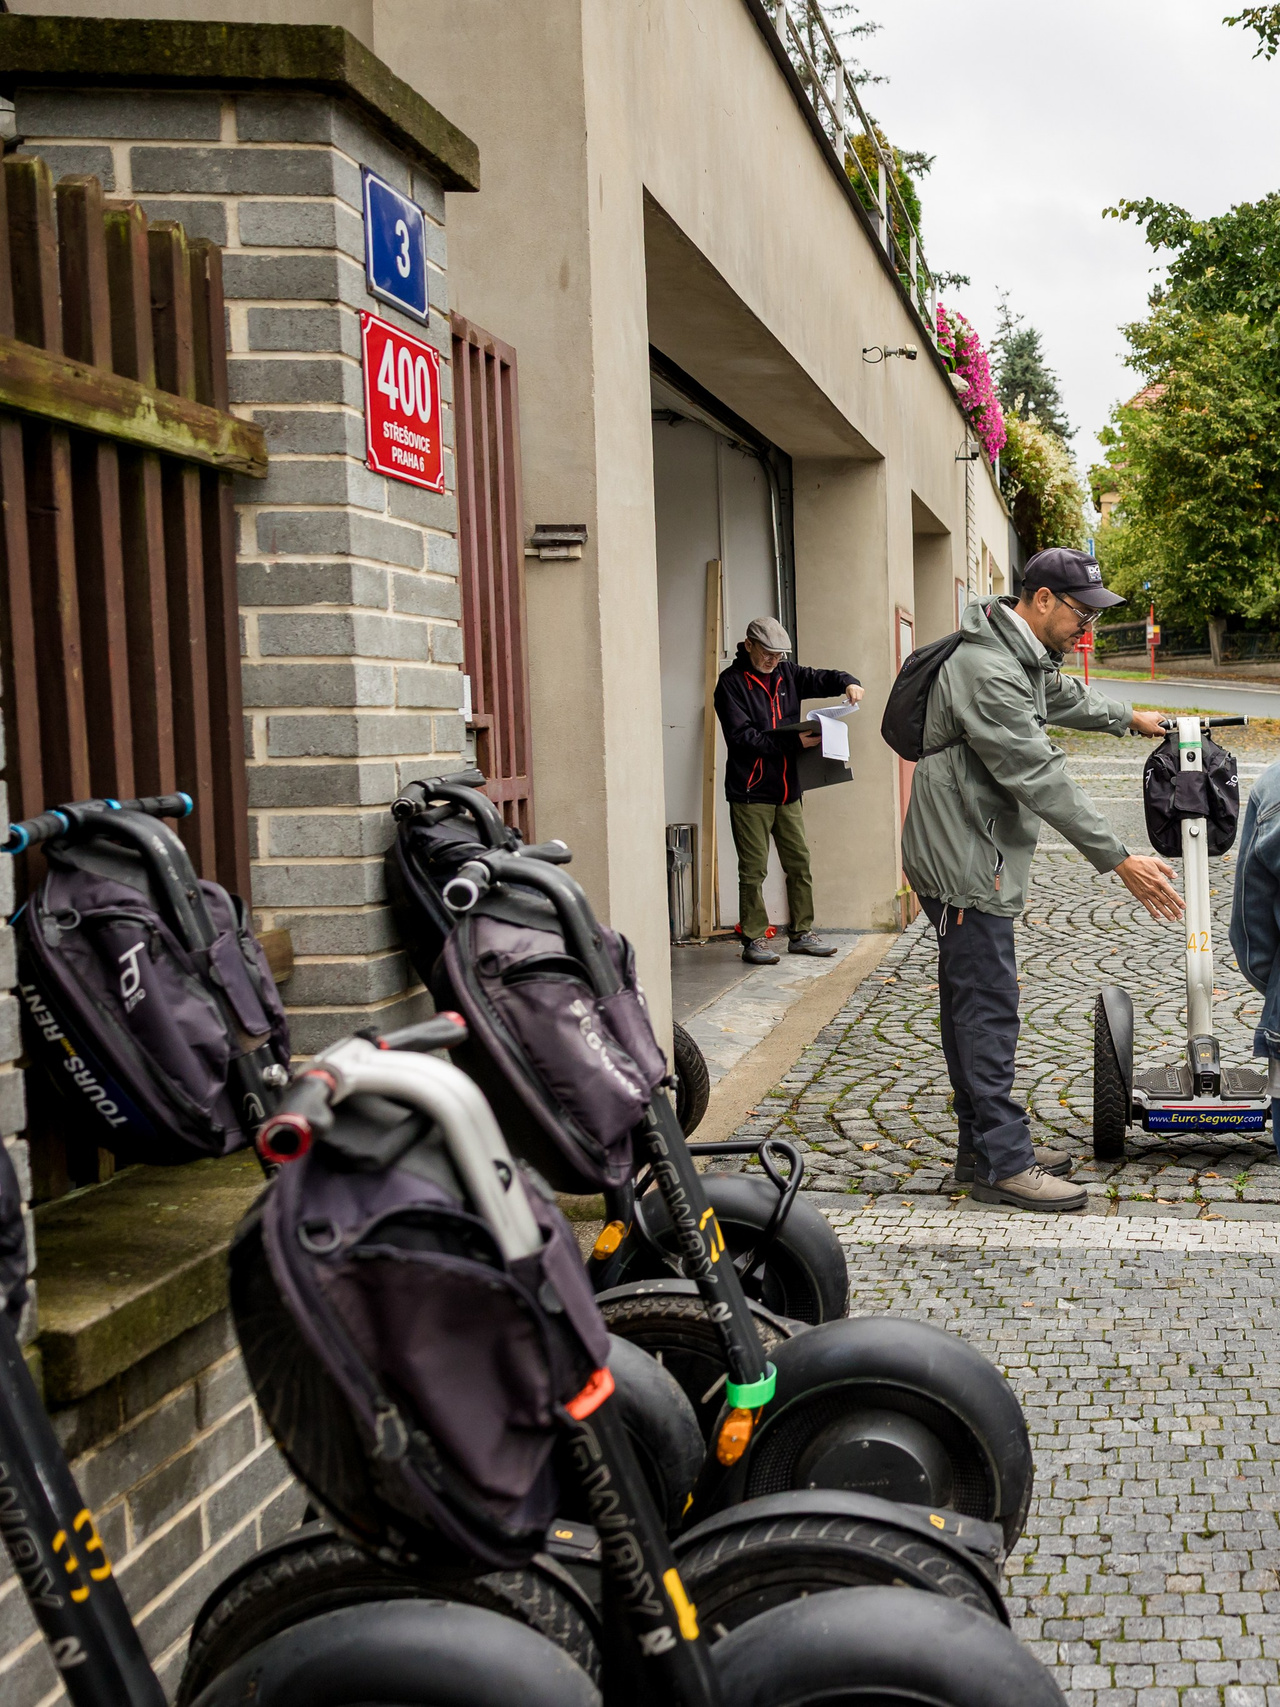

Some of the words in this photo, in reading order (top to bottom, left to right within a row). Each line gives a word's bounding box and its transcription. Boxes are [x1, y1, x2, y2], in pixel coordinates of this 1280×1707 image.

[395, 219, 411, 279] 3
[377, 338, 432, 424] 400
[383, 421, 431, 454] STŘEŠOVICE
[391, 446, 419, 471] PRAHA
[419, 460, 425, 472] 6
[1187, 931, 1210, 953] 42
[20, 984, 65, 1042] RENT
[63, 1056, 128, 1129] TOURS
